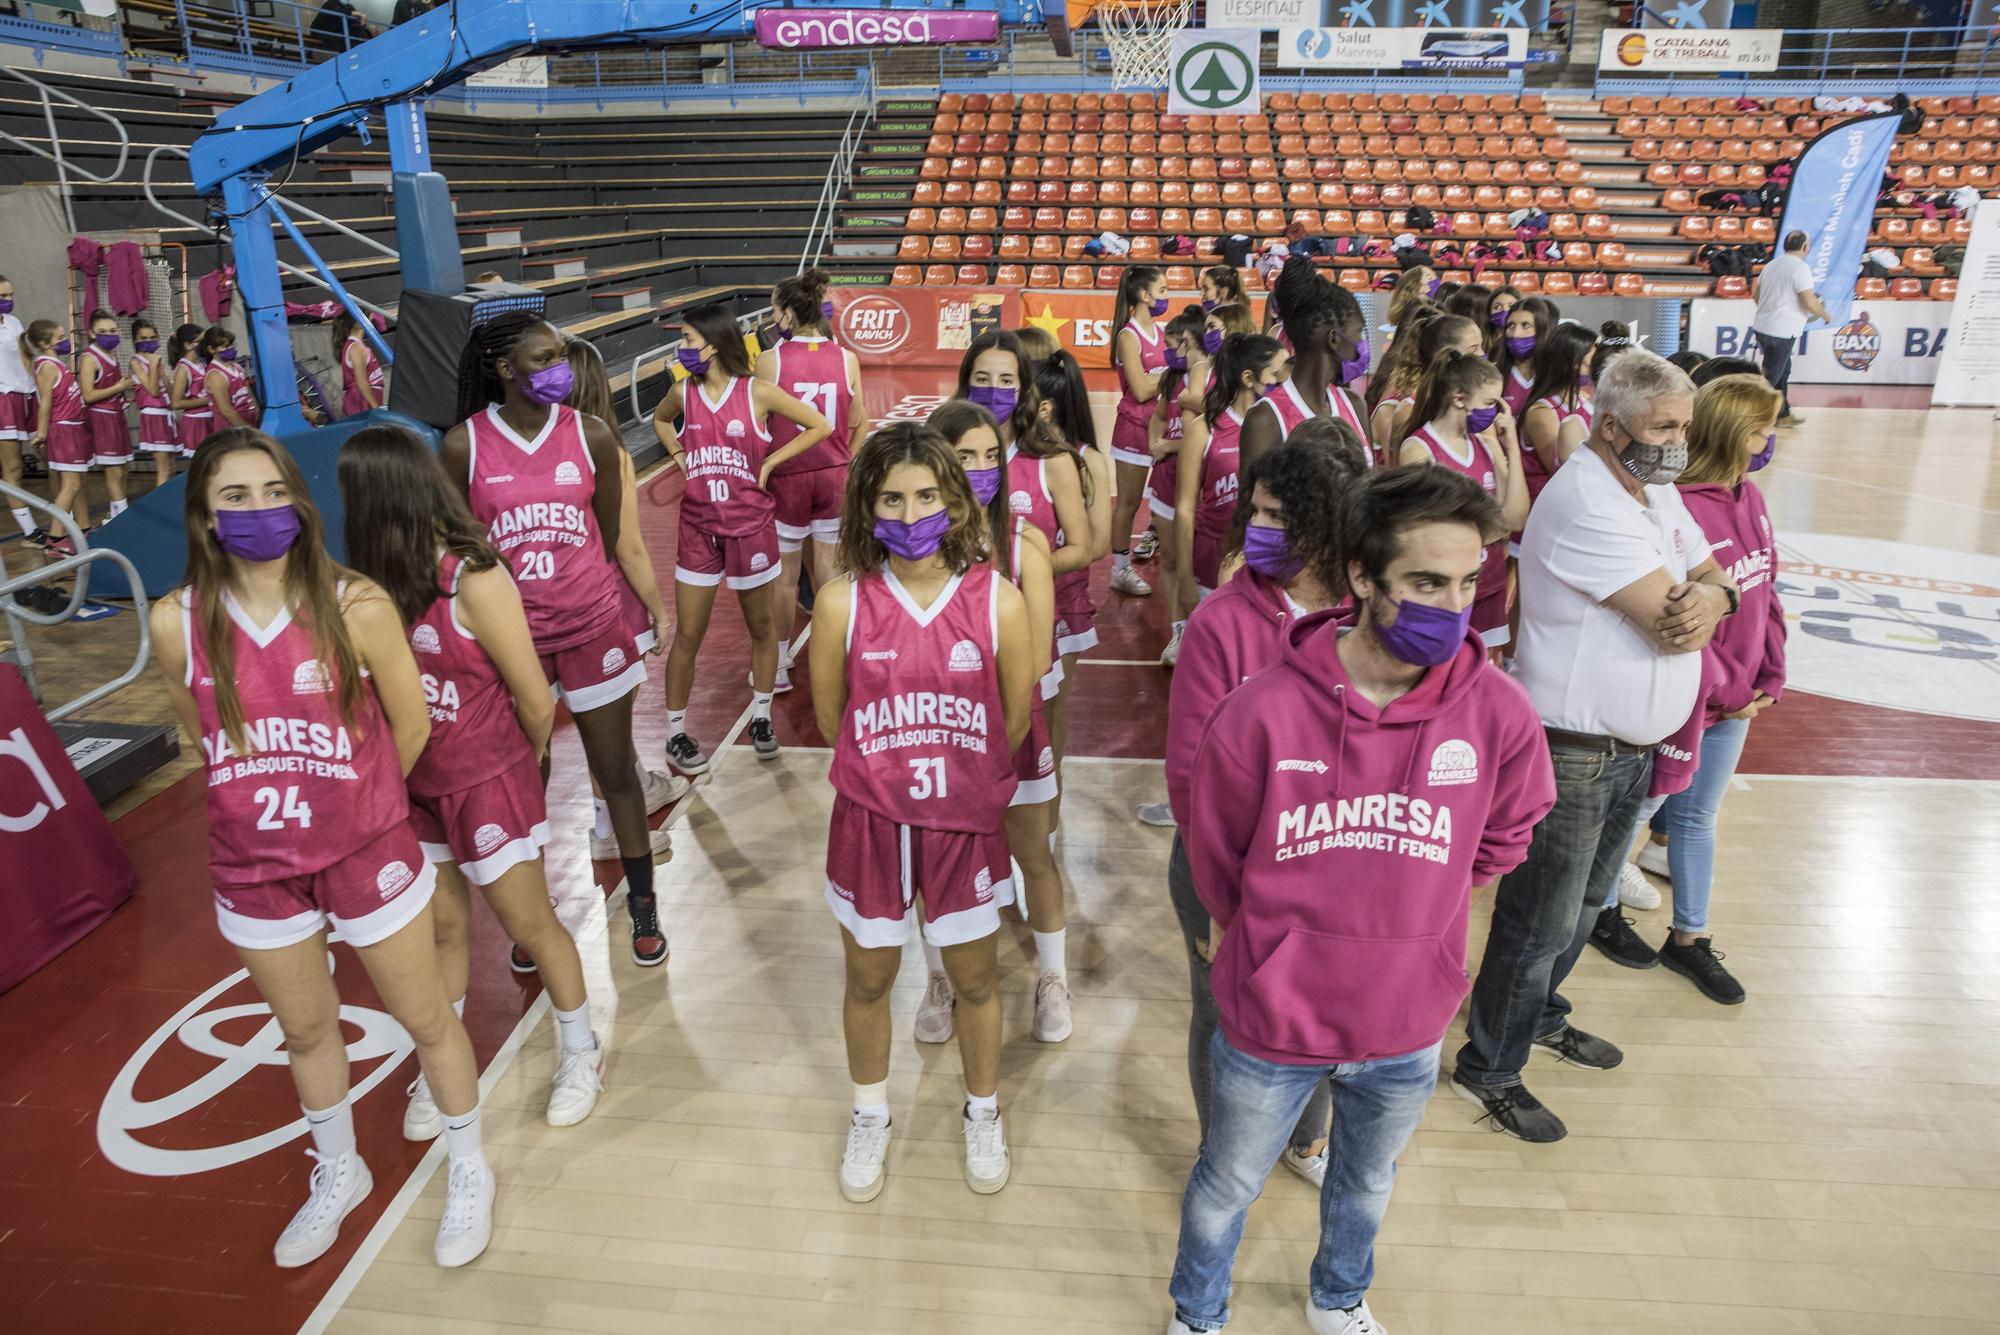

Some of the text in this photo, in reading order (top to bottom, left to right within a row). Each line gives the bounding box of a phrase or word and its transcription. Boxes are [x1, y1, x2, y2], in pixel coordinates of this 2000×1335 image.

[776, 10, 930, 47] endesa
[1337, 31, 1371, 44] Salut
[855, 191, 908, 200] BROWN TAILOR
[1811, 234, 1835, 283] Motor
[1823, 171, 1855, 232] Munich
[849, 309, 901, 330] FRIT
[854, 329, 894, 341] RAVICH
[1834, 334, 1880, 351] BAXI
[793, 382, 837, 432] 31
[707, 479, 730, 503] 10
[518, 550, 555, 581] 20
[853, 692, 988, 741] MANRESA
[889, 728, 951, 749] BÀSQUET
[235, 756, 306, 780] BÀSQUET
[909, 756, 948, 801] 31
[1427, 768, 1479, 782] MANRESA
[254, 785, 313, 831] 24
[1276, 792, 1453, 846] MANRESA
[1275, 830, 1451, 866] CLUB BÀSQUET FEMENÍ
